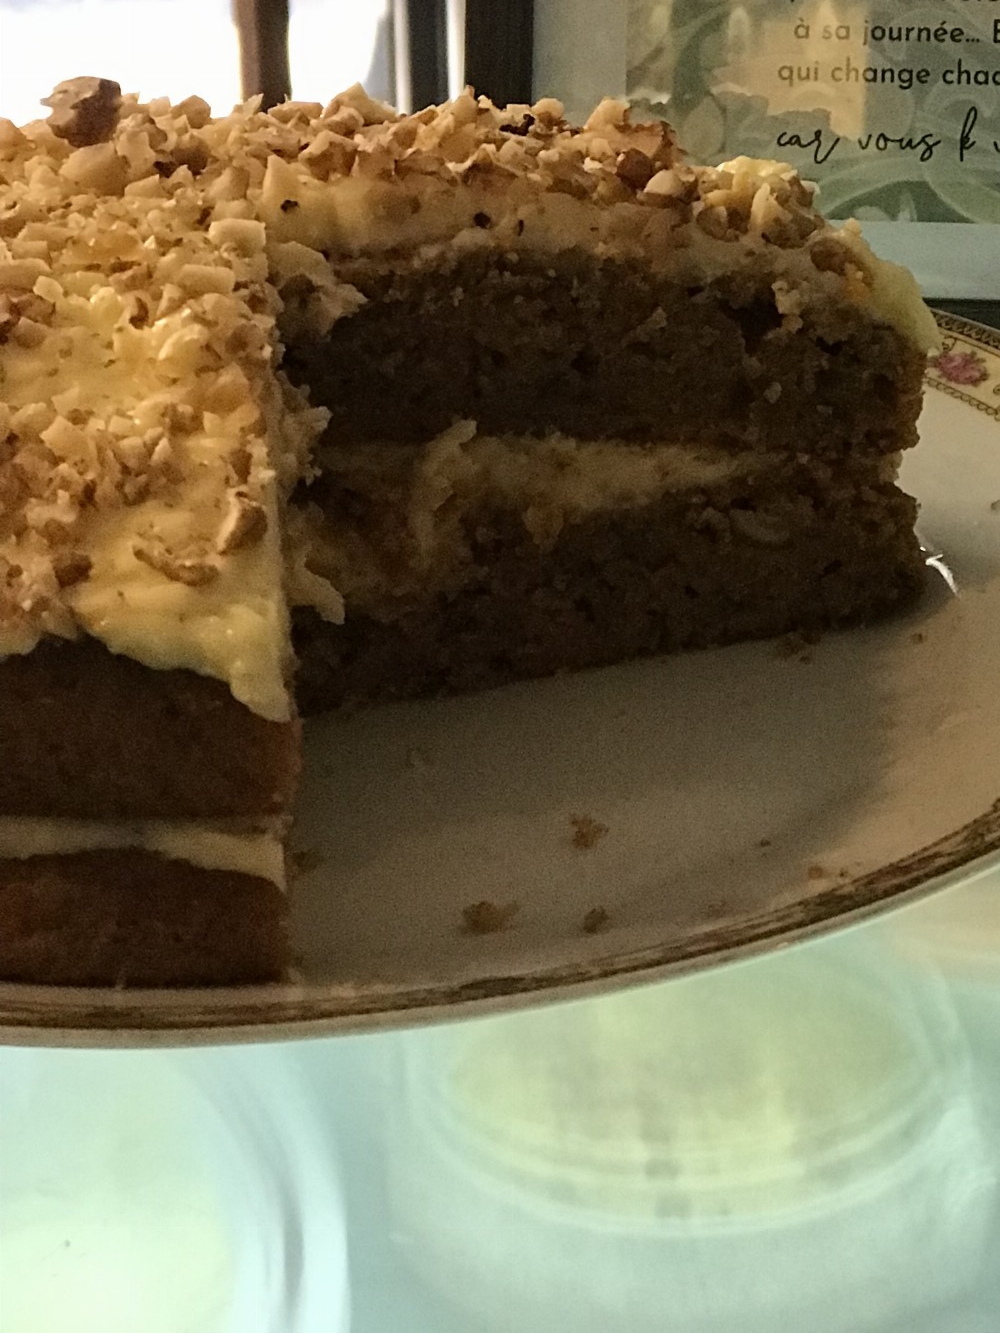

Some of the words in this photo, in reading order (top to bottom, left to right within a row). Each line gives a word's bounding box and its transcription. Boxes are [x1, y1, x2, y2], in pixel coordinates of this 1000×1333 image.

[794, 17, 810, 39] à
[822, 21, 851, 41] sa
[862, 21, 980, 43] journée...
[778, 66, 818, 87] qui
[830, 62, 931, 91] change
[777, 129, 840, 164] car
[859, 133, 941, 162] vous
